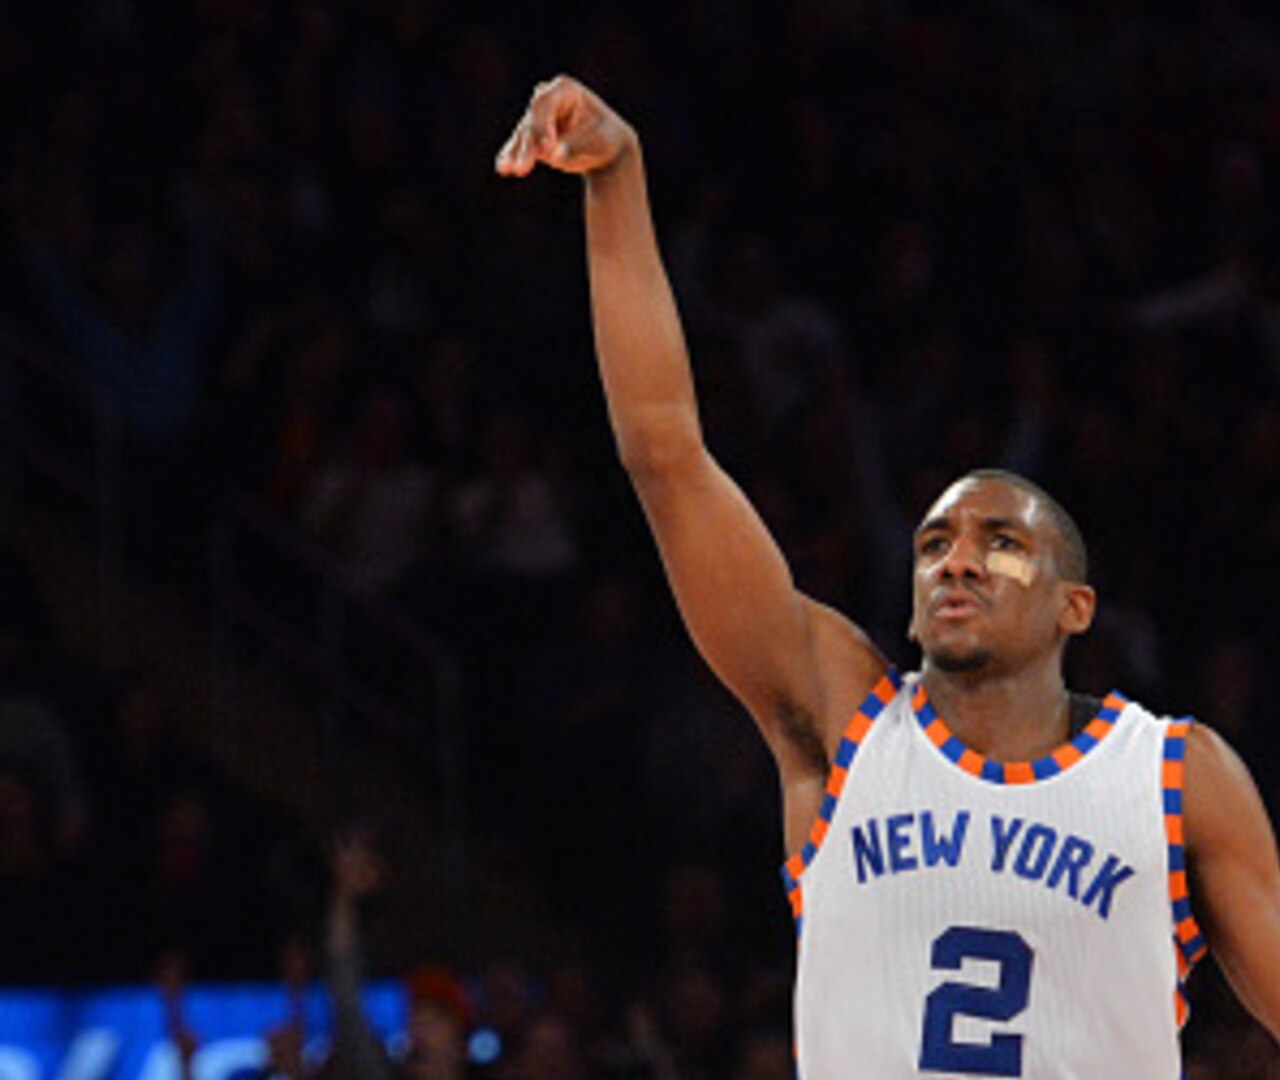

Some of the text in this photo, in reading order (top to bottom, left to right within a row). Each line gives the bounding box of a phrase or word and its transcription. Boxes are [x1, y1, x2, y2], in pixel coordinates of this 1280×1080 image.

[850, 809, 1136, 921] NEW YORK
[917, 924, 1036, 1079] 2
